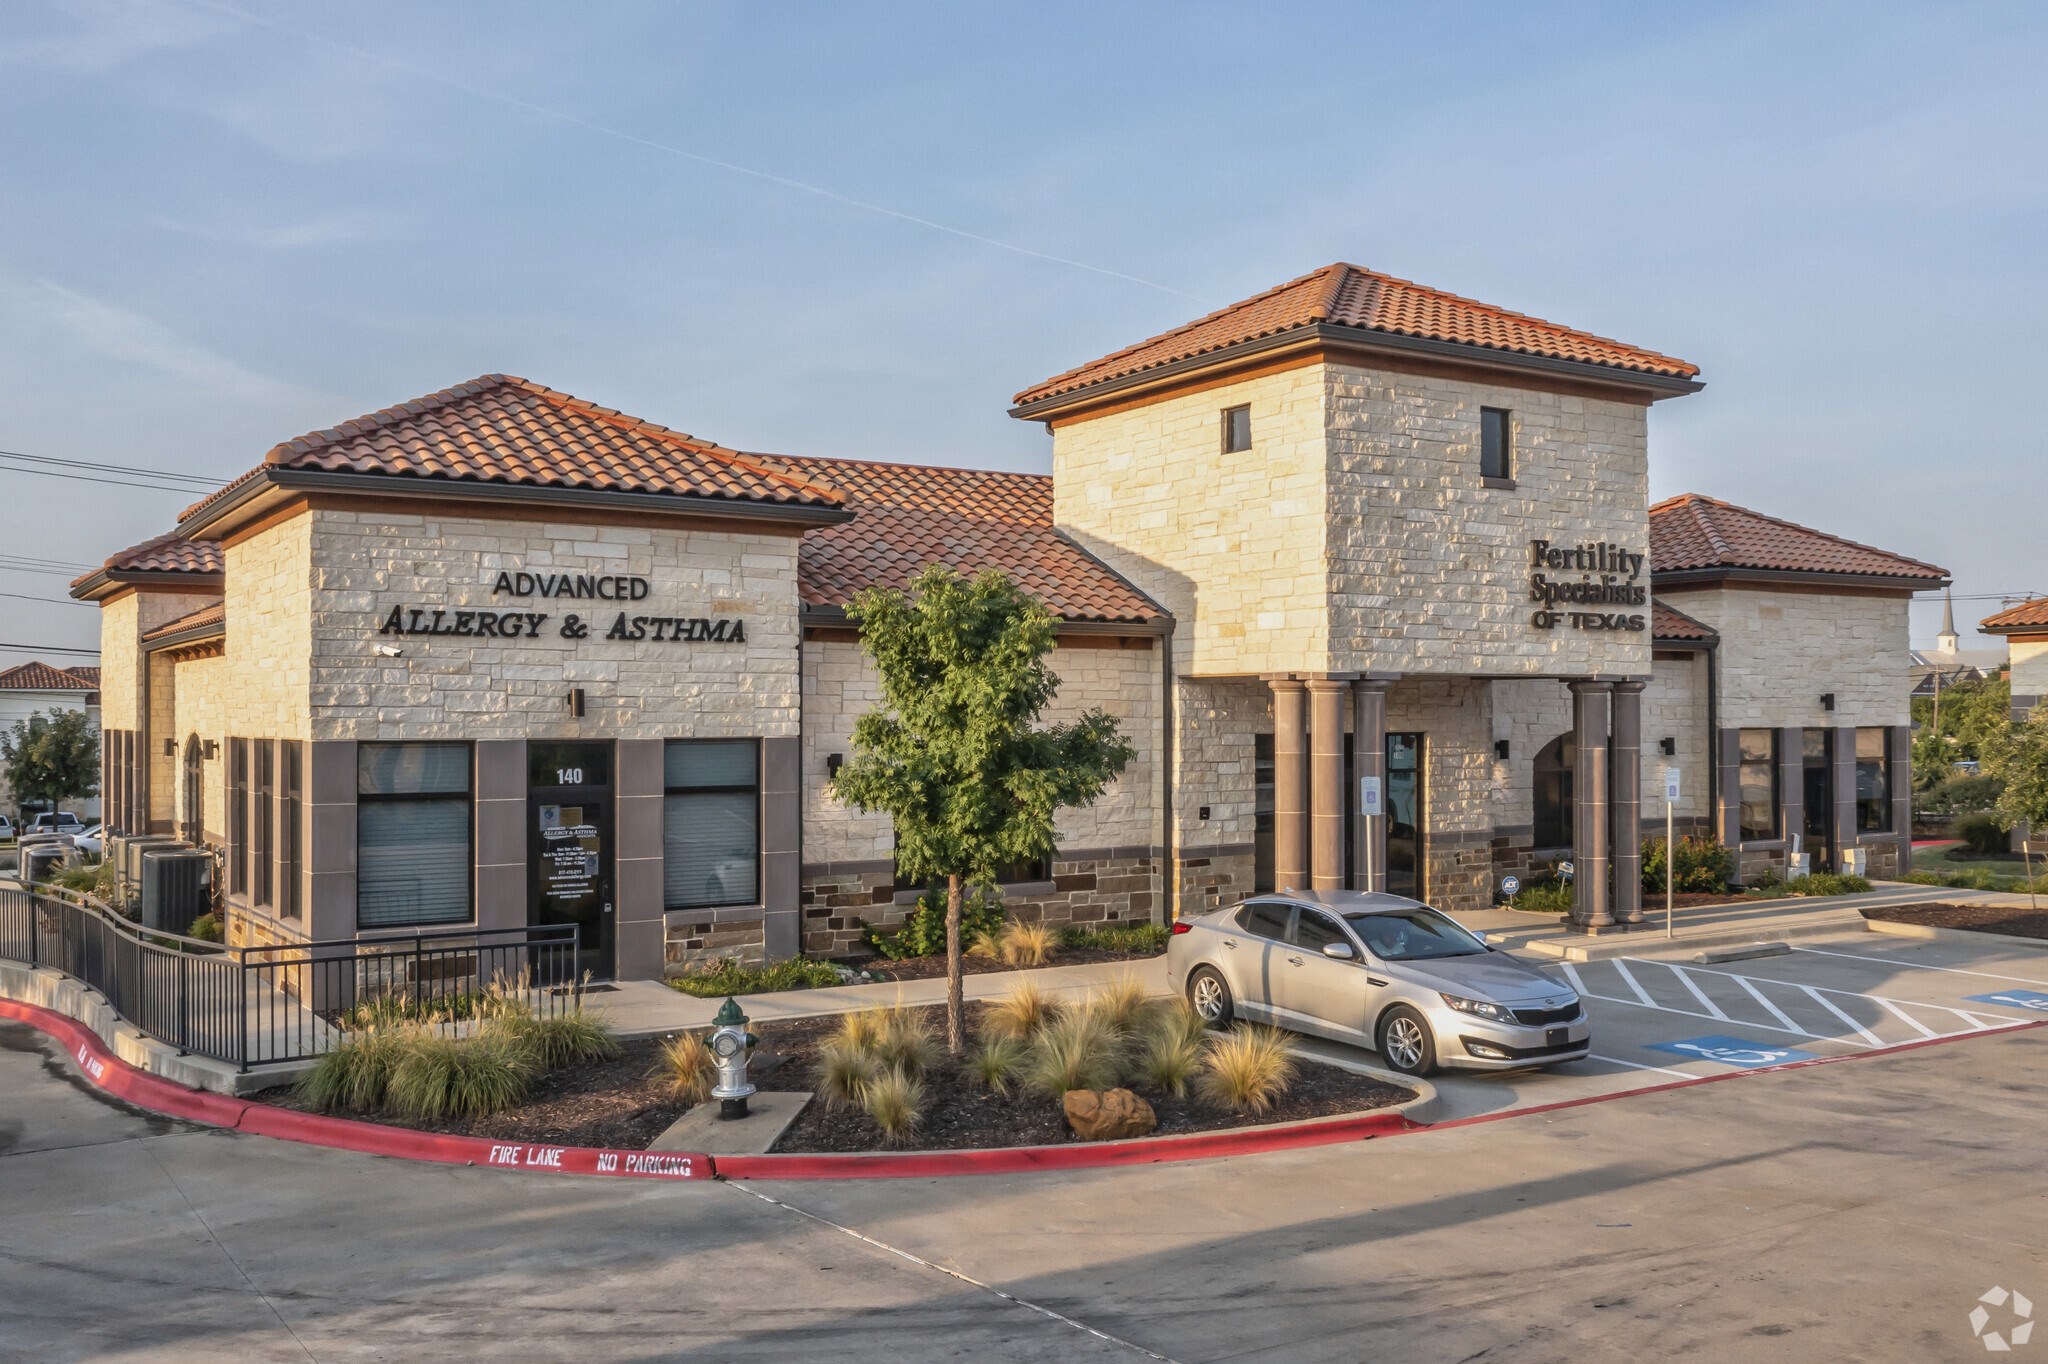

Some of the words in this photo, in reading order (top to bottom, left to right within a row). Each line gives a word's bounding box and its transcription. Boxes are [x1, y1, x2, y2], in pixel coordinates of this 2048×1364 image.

[1530, 540, 1644, 580] Fertility
[493, 571, 649, 600] ADVANCED
[1529, 573, 1646, 610] Specialists
[379, 604, 548, 638] ALLERGY
[559, 613, 588, 639] &
[605, 611, 746, 643] ASTHMA
[1531, 610, 1565, 629] OF
[1567, 611, 1646, 631] TEXAS
[556, 767, 583, 785] 140
[489, 1145, 522, 1165] FIRE
[526, 1148, 565, 1167] LANE
[597, 1152, 617, 1172] NO
[625, 1154, 693, 1177] PARKING
